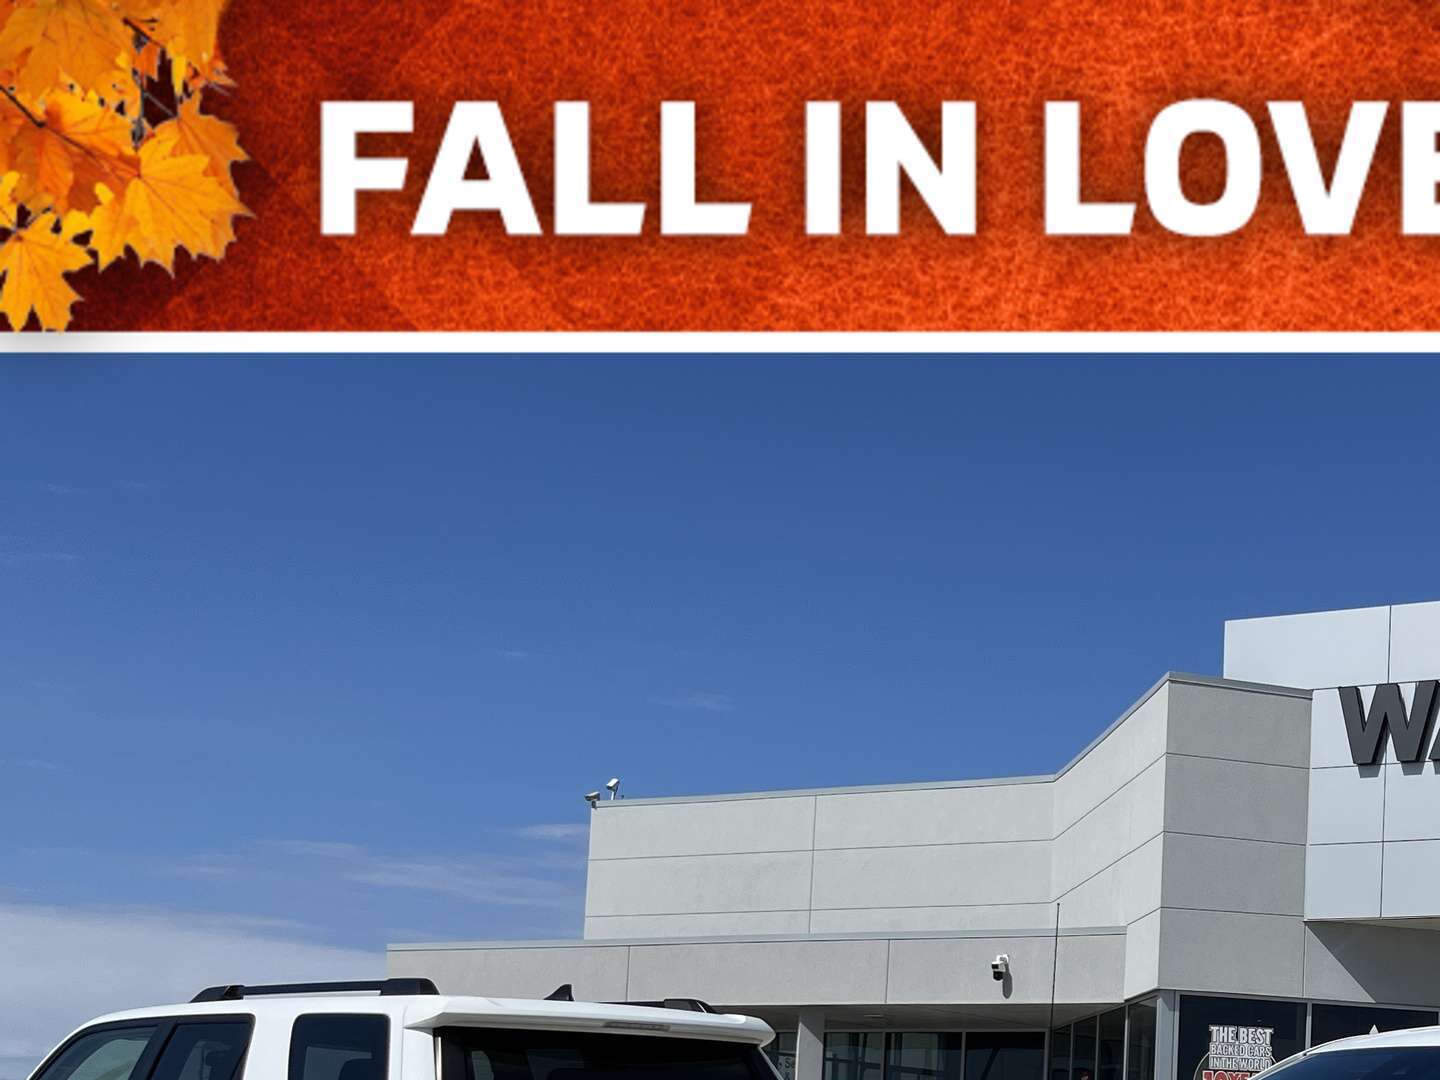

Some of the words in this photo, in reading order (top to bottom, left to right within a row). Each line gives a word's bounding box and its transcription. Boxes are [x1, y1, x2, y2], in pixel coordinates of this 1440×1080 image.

[1209, 1025, 1237, 1042] THE
[1239, 1027, 1274, 1046] BEST
[1209, 1044, 1246, 1057] BACKED
[1248, 1045, 1273, 1058] CARS
[1209, 1057, 1220, 1069] IN
[1221, 1057, 1238, 1070] THE
[1239, 1058, 1273, 1072] WORLD
